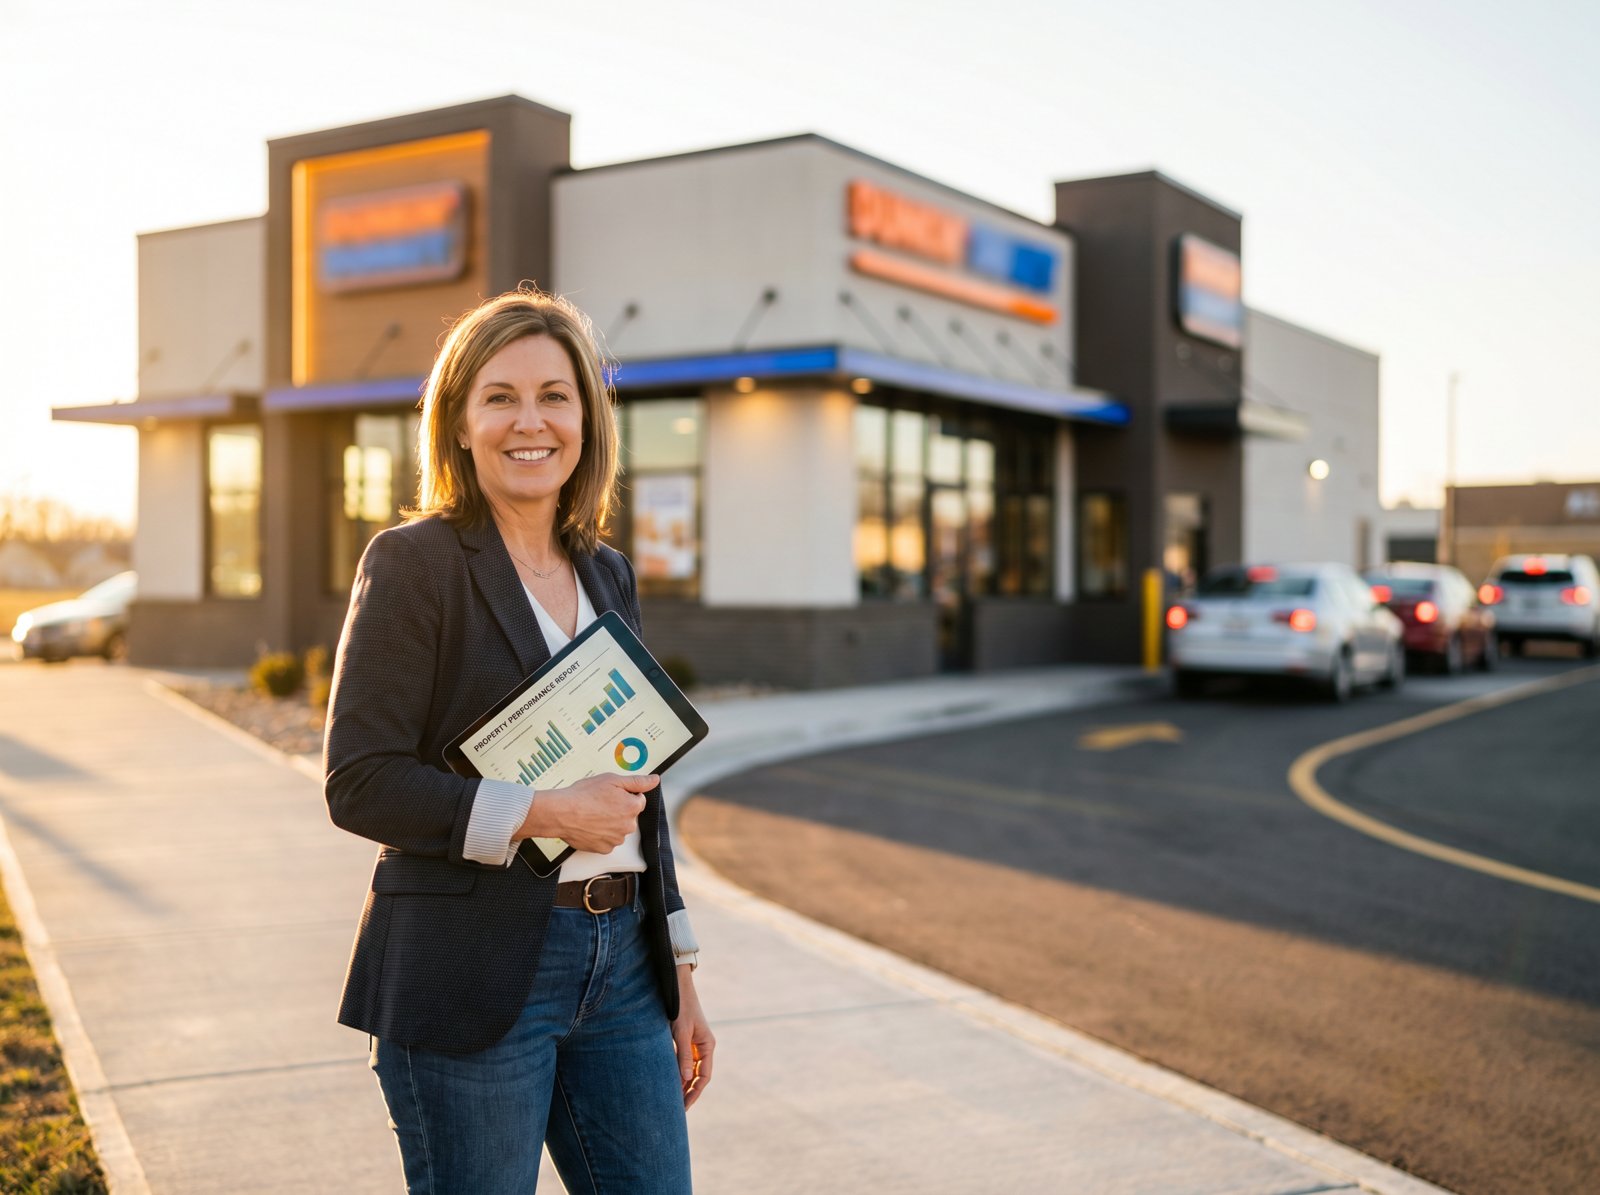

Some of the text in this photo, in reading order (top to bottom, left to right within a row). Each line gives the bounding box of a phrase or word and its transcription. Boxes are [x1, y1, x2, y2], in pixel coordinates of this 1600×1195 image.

[473, 721, 508, 752] PROPERTY
[508, 682, 556, 724] PERFORMANCE
[555, 660, 581, 685] REPORT
